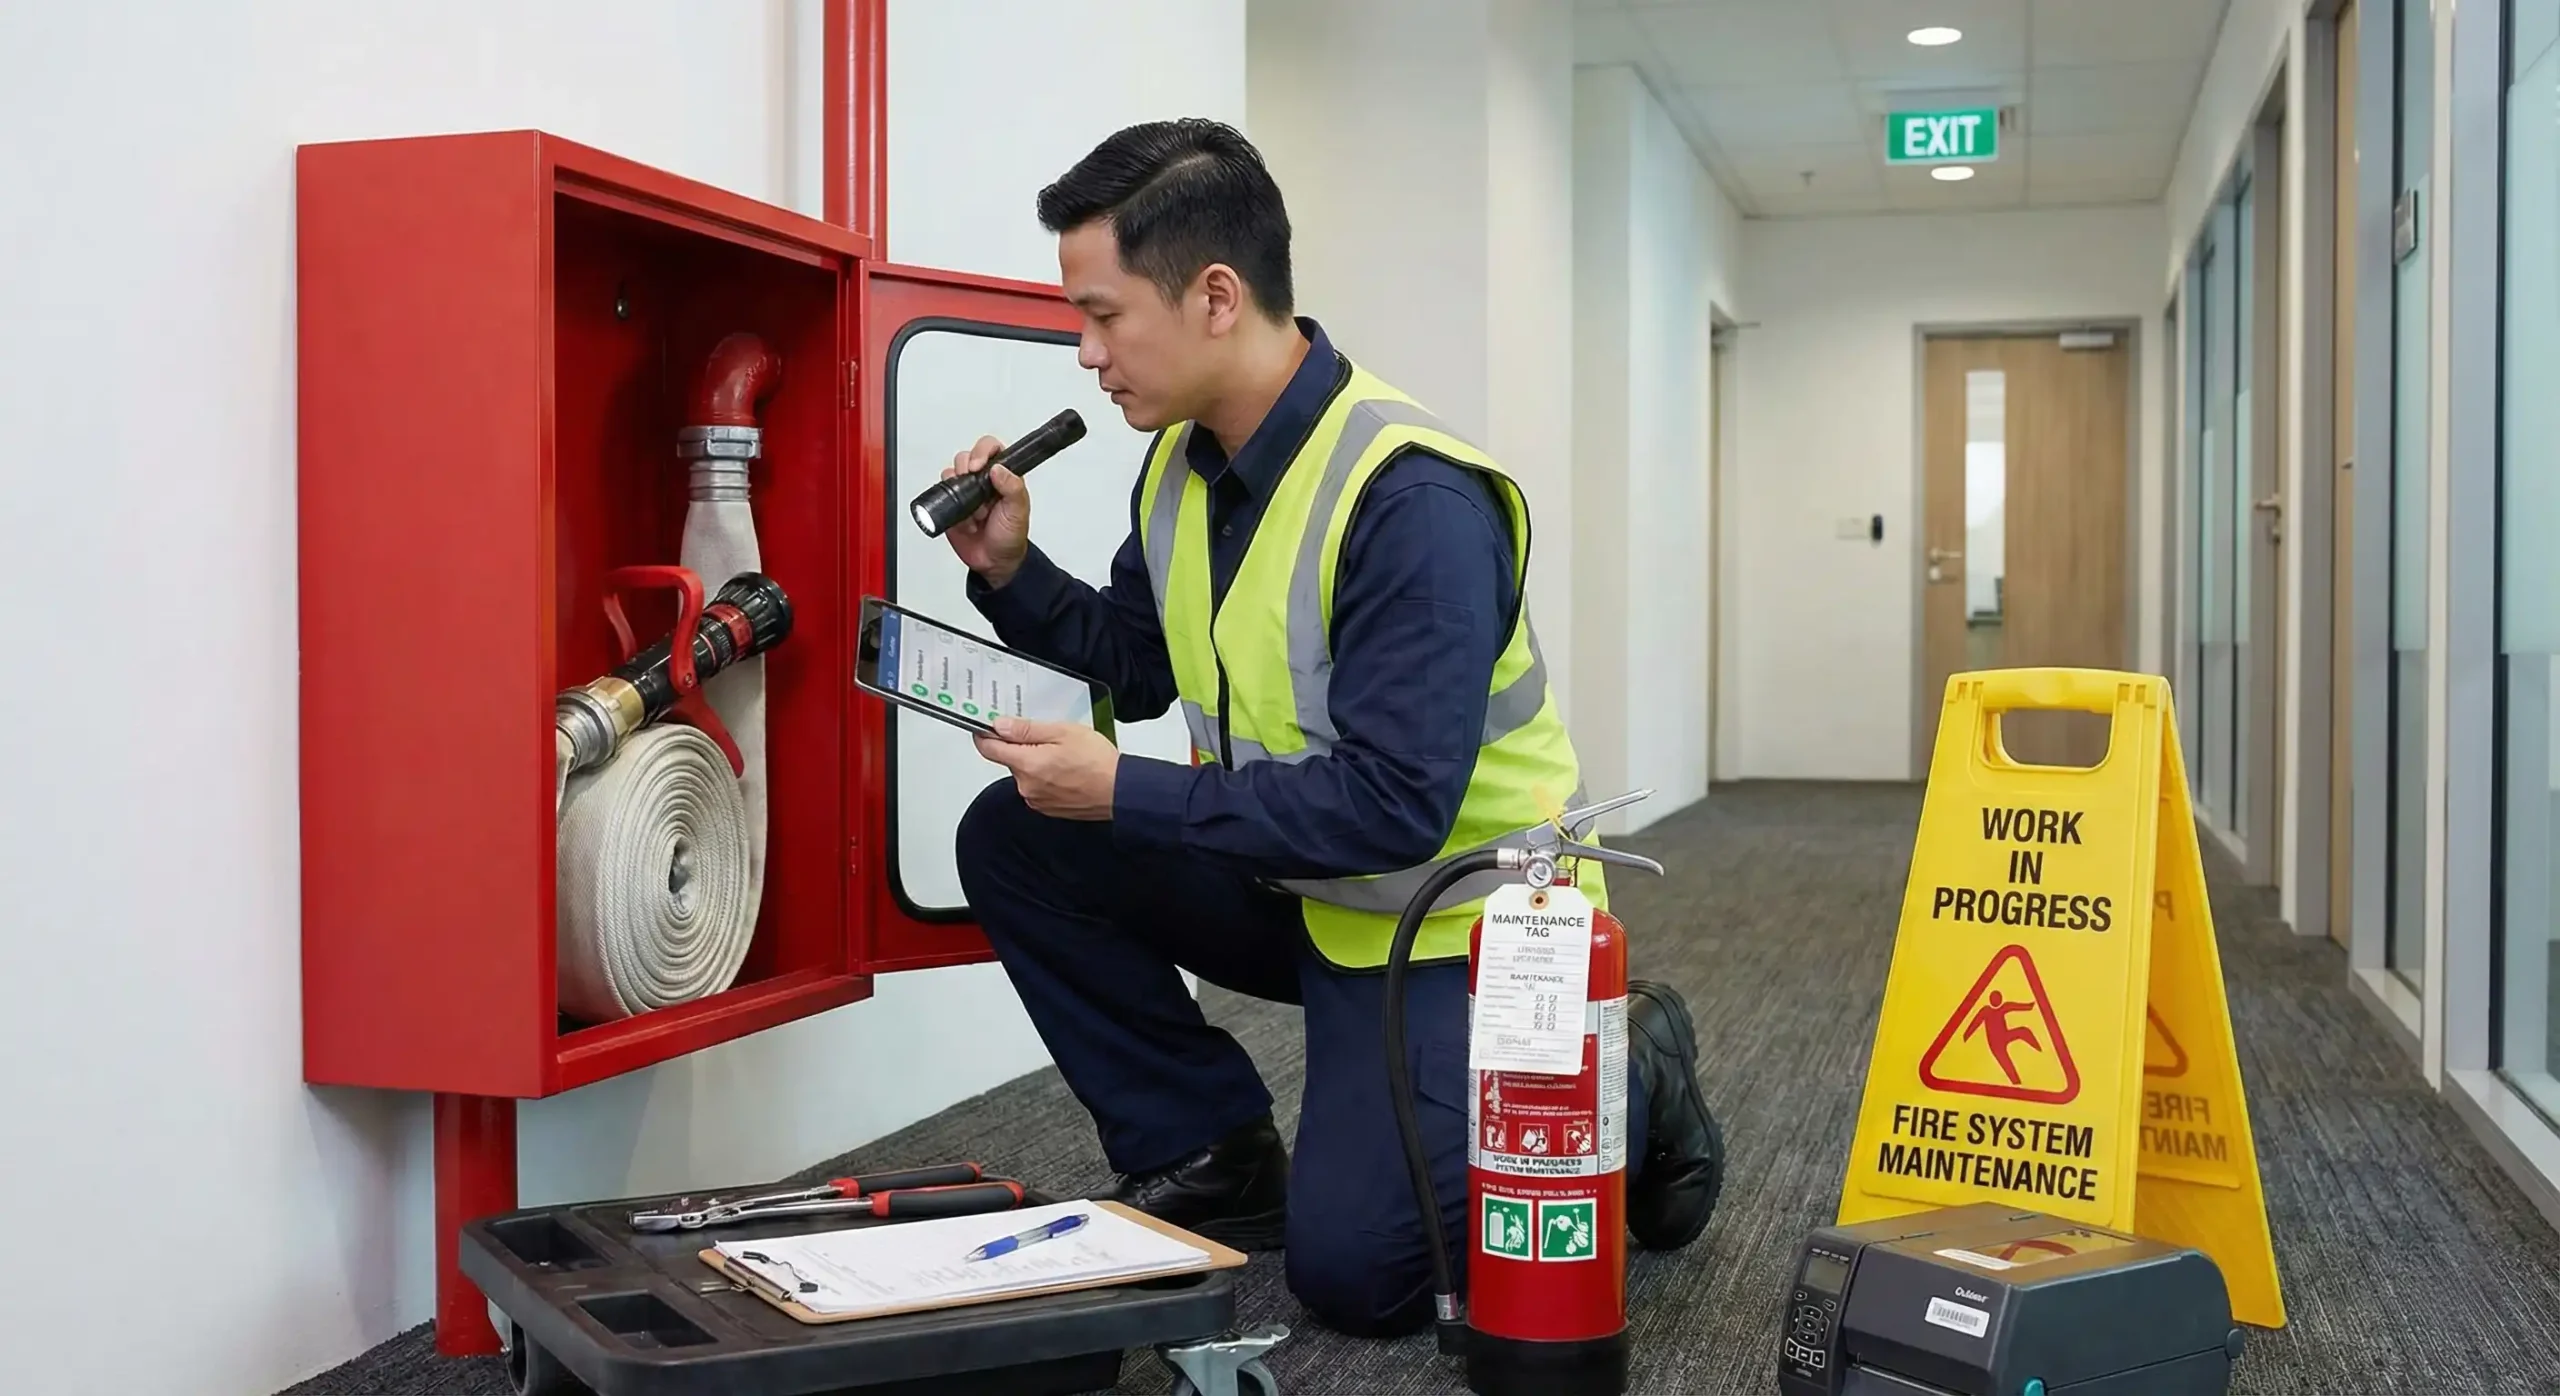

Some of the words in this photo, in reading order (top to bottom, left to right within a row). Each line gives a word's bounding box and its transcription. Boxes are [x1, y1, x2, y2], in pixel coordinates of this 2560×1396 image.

[1904, 115, 1981, 156] EXIT
[1982, 807, 2084, 845] WORK
[2008, 850, 2044, 885] IN
[1492, 914, 1585, 927] MAINTENANCE
[1932, 887, 2112, 932] PROGRESS
[1525, 926, 1550, 938] TAG
[1892, 1104, 1958, 1142] FIRE
[1966, 1113, 2094, 1159] SYSTEM
[1877, 1142, 2099, 1202] MAINTENANCE
